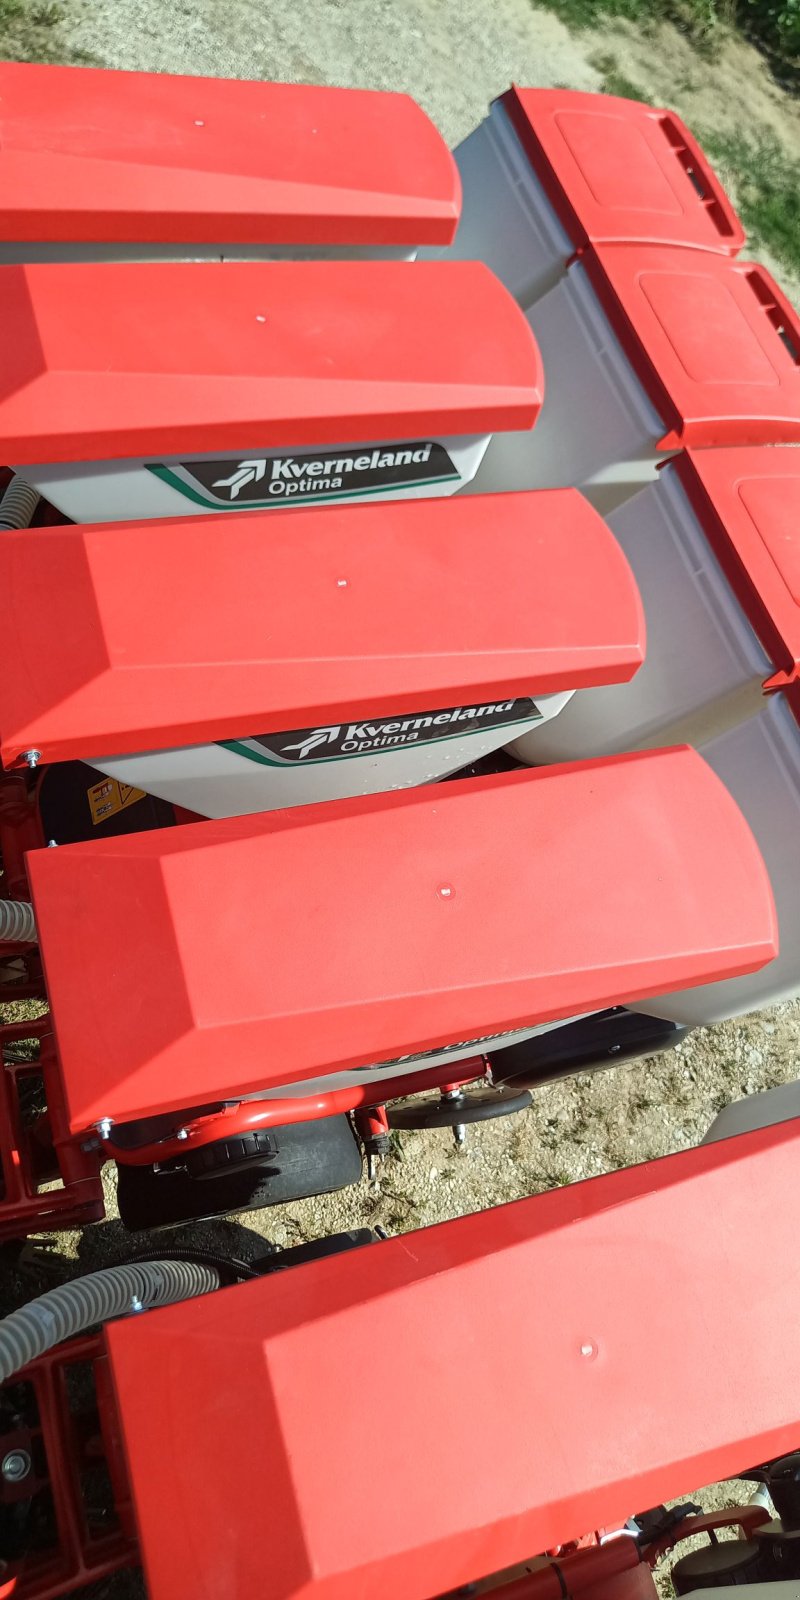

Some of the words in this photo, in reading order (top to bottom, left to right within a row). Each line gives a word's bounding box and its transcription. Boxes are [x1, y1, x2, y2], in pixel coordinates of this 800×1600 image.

[271, 443, 433, 479] Kverneland
[268, 477, 343, 496] Optima
[344, 699, 517, 741] Kverneland
[340, 731, 419, 752] Optima
